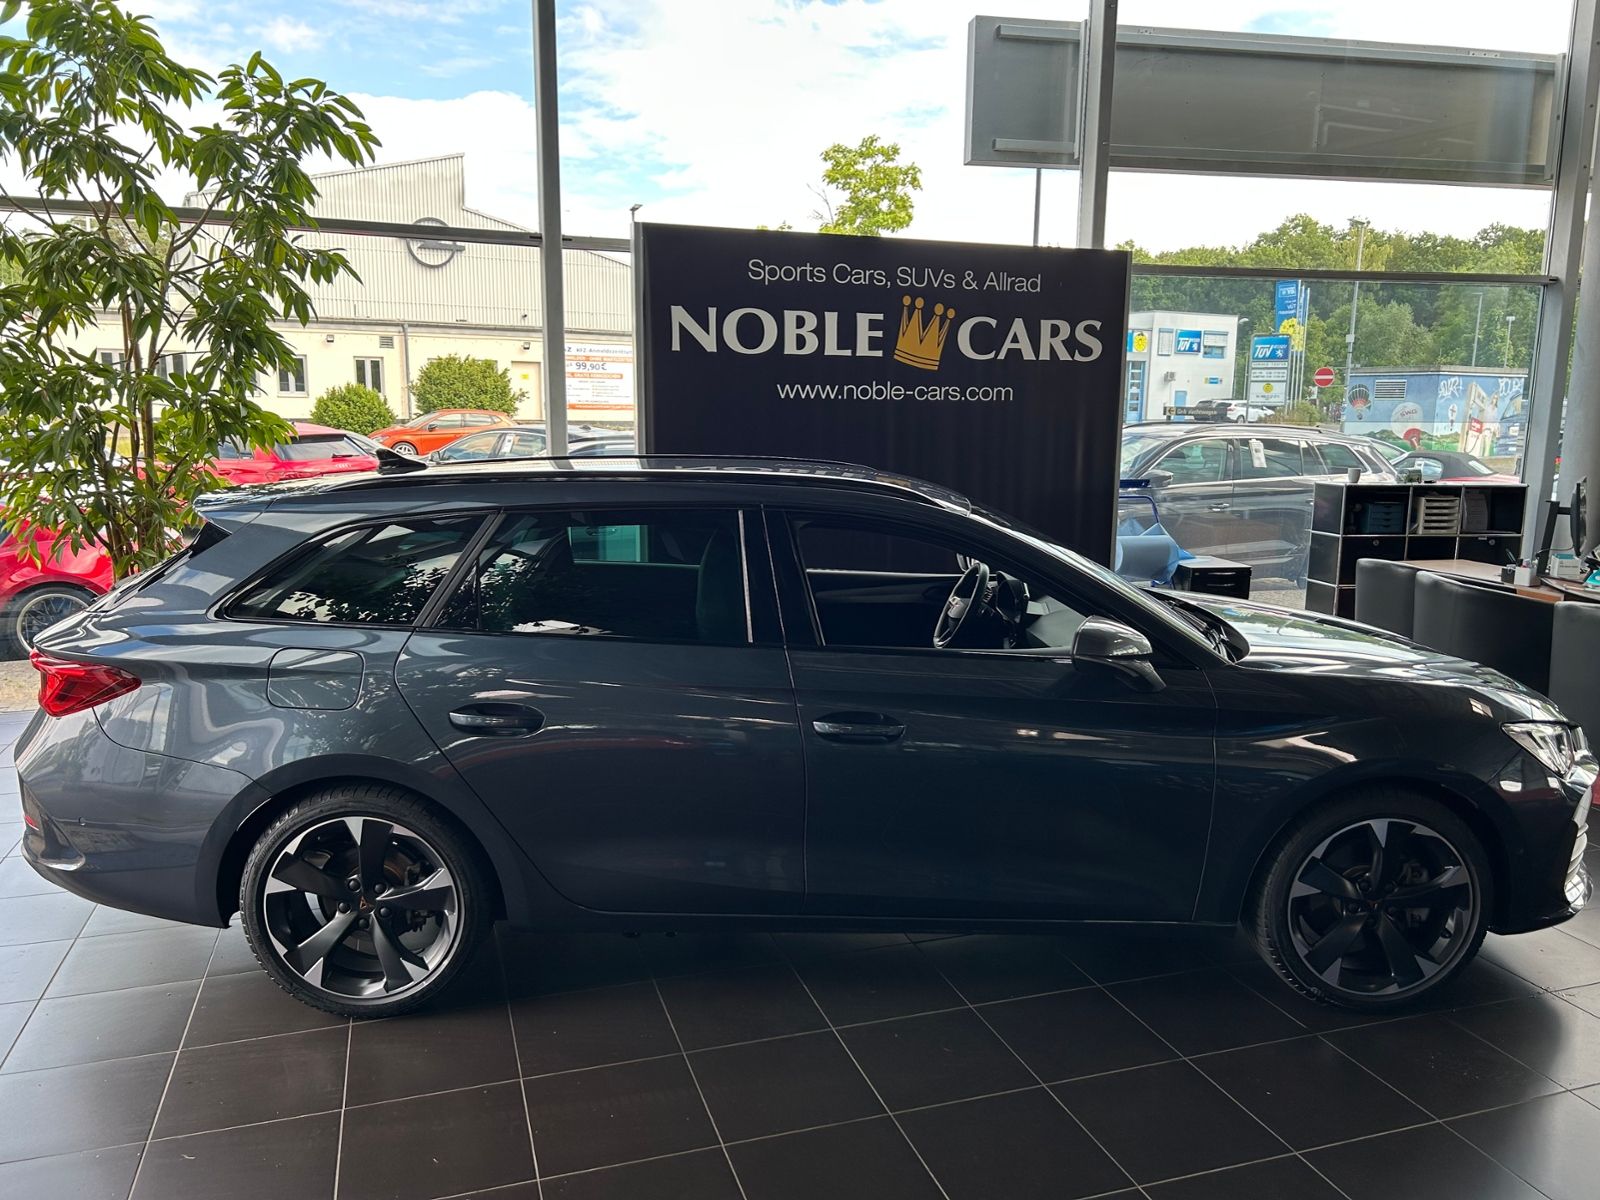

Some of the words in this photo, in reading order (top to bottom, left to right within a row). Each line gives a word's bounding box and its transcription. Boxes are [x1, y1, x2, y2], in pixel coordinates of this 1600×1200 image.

[748, 259, 826, 285] Sports
[833, 263, 891, 288] Cars,
[897, 266, 955, 289] SUVs
[962, 270, 978, 290] &
[983, 272, 1041, 292] Allrad
[670, 305, 884, 357] NOBLE
[957, 316, 1103, 362] CARS
[777, 381, 1013, 401] www.noble-cars.com
